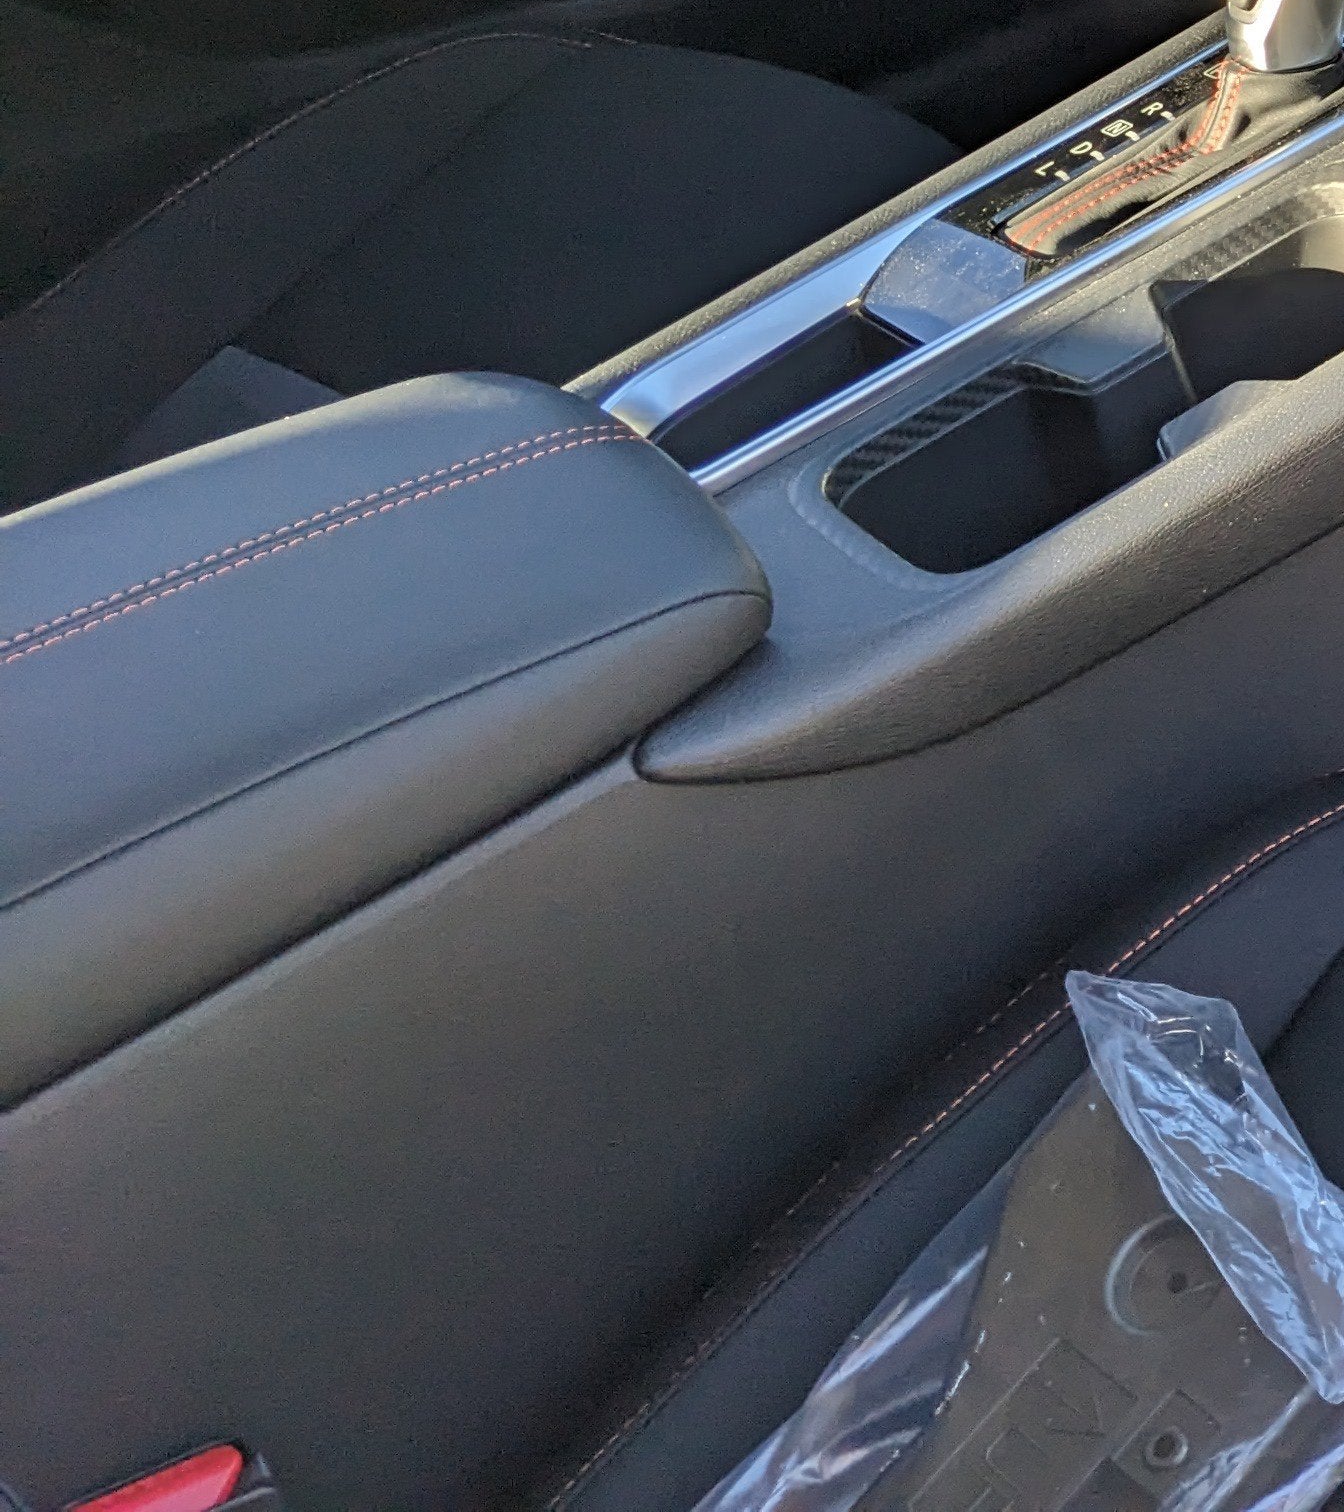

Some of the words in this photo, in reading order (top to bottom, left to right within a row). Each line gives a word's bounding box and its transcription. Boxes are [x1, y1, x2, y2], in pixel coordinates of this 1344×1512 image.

[1141, 101, 1163, 116] R
[1109, 121, 1126, 135] N
[1070, 141, 1093, 155] D
[1034, 160, 1055, 177] L
